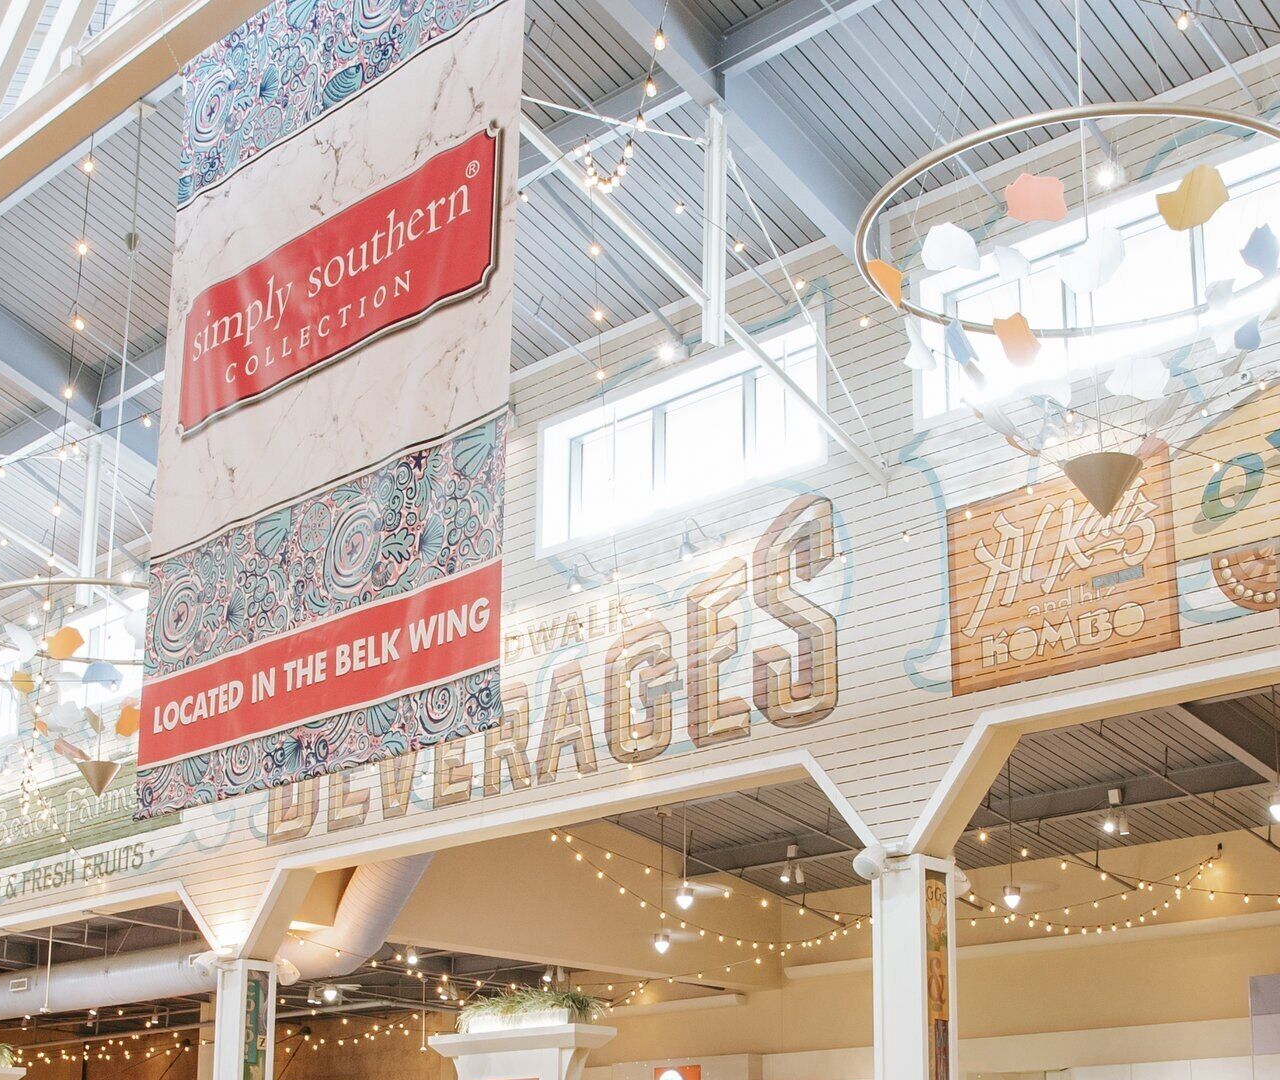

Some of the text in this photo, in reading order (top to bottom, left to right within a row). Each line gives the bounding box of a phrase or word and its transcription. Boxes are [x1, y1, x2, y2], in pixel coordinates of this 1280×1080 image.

[193, 184, 472, 362] simply southern
[225, 270, 413, 384] COLLECTION
[504, 594, 633, 665] DWALK
[981, 601, 1146, 669] KOMBO
[1027, 587, 1072, 618] and
[153, 597, 491, 735] LOCATED IN THE BELK WING
[5, 874, 18, 899] &
[22, 861, 76, 895] FRESH
[82, 842, 145, 880] FRUITS
